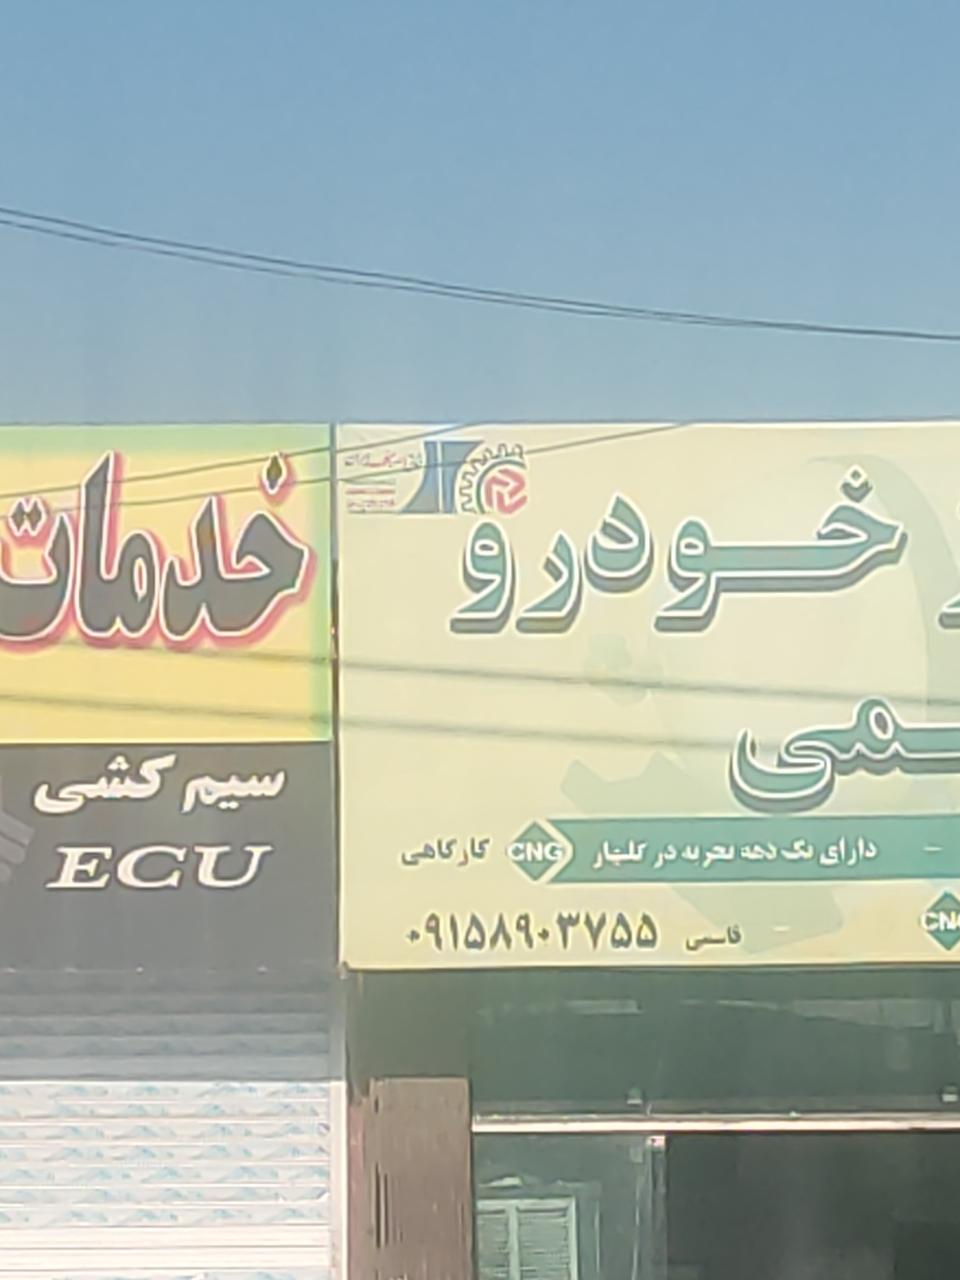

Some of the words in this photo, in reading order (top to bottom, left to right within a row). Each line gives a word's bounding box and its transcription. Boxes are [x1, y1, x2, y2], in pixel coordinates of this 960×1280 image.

[0, 451, 314, 652] خدمات
[449, 464, 908, 635] خودرو
[33, 753, 177, 815] کشی
[180, 769, 287, 814] سیم
[45, 844, 274, 890] ECU
[506, 840, 565, 862] CNG
[818, 836, 878, 866] دارای
[405, 910, 659, 951] ۰۹۱۵۸۹۰۳۷۵۵
